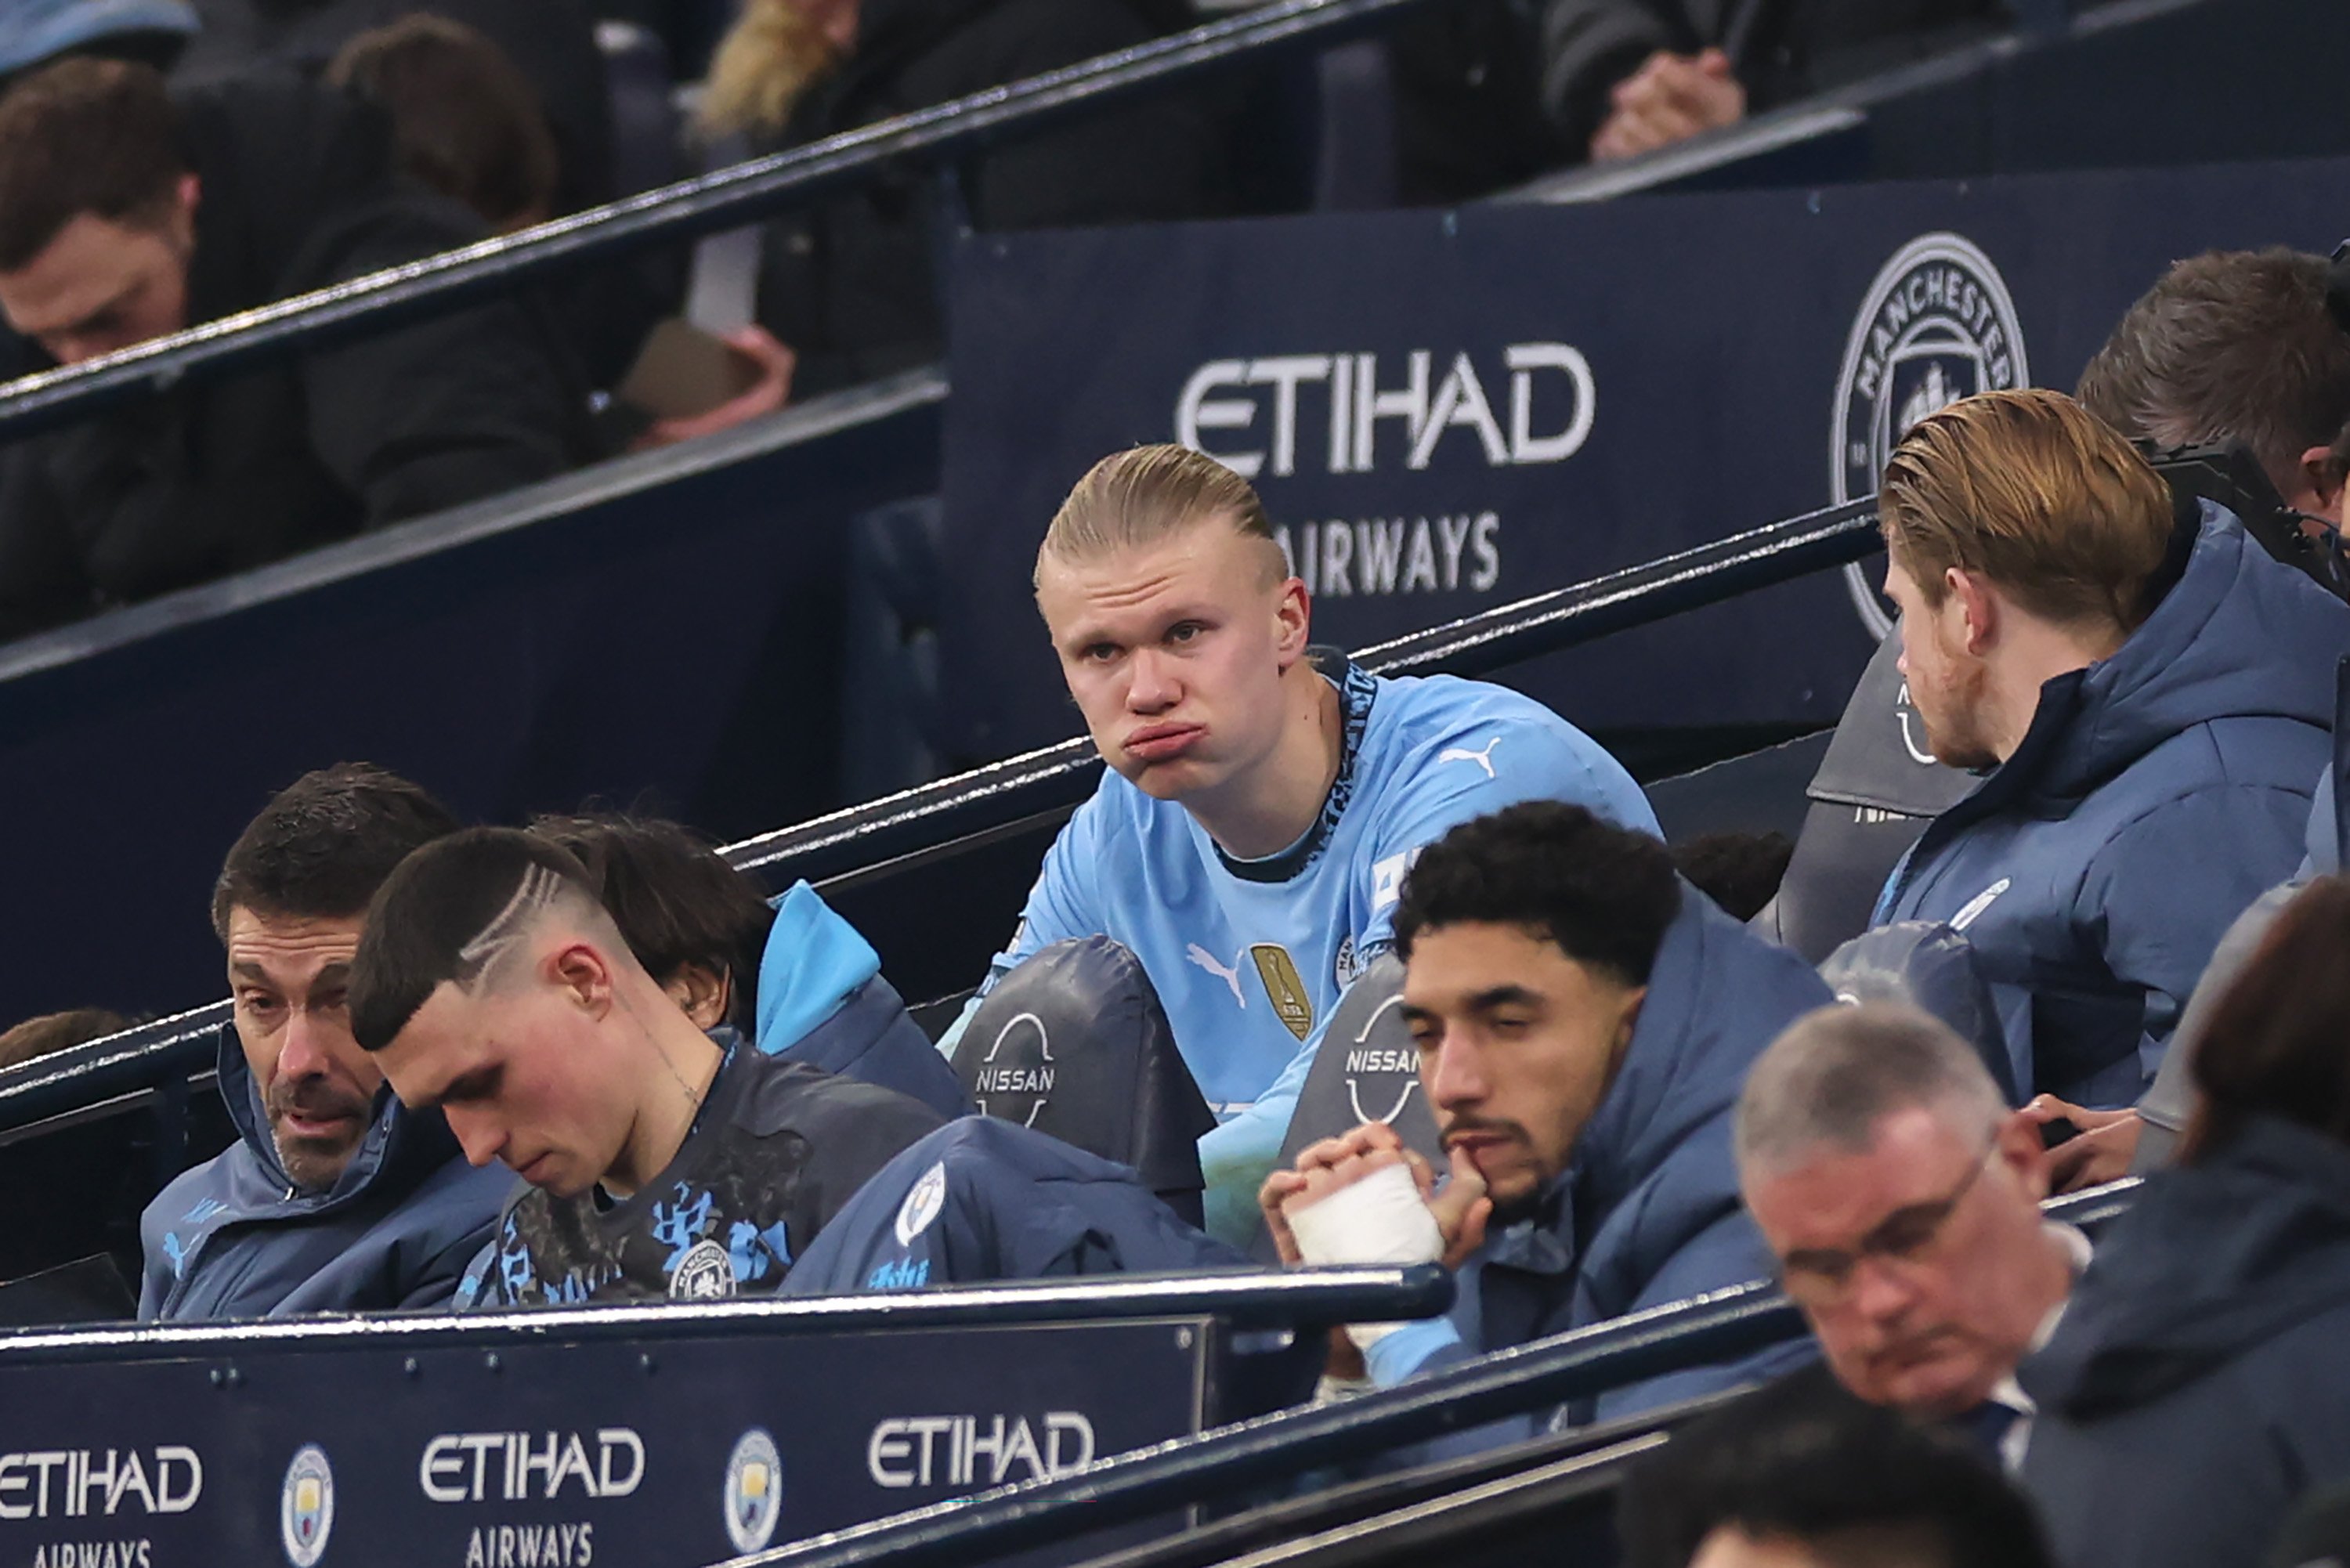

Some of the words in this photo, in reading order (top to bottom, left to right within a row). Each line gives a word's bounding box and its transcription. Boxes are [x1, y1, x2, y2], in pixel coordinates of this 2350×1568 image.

[1856, 269, 2011, 400] MANCHESTER
[1176, 342, 1596, 477] ETIHAD
[976, 1068, 1054, 1093] NISSAN
[1346, 1050, 1423, 1073] NISSAN
[0, 1445, 203, 1519] ETIHAD
[420, 1427, 645, 1502] ETIHAD
[868, 1411, 1095, 1487] ETIHAD
[465, 1522, 593, 1568] AIRWAYS
